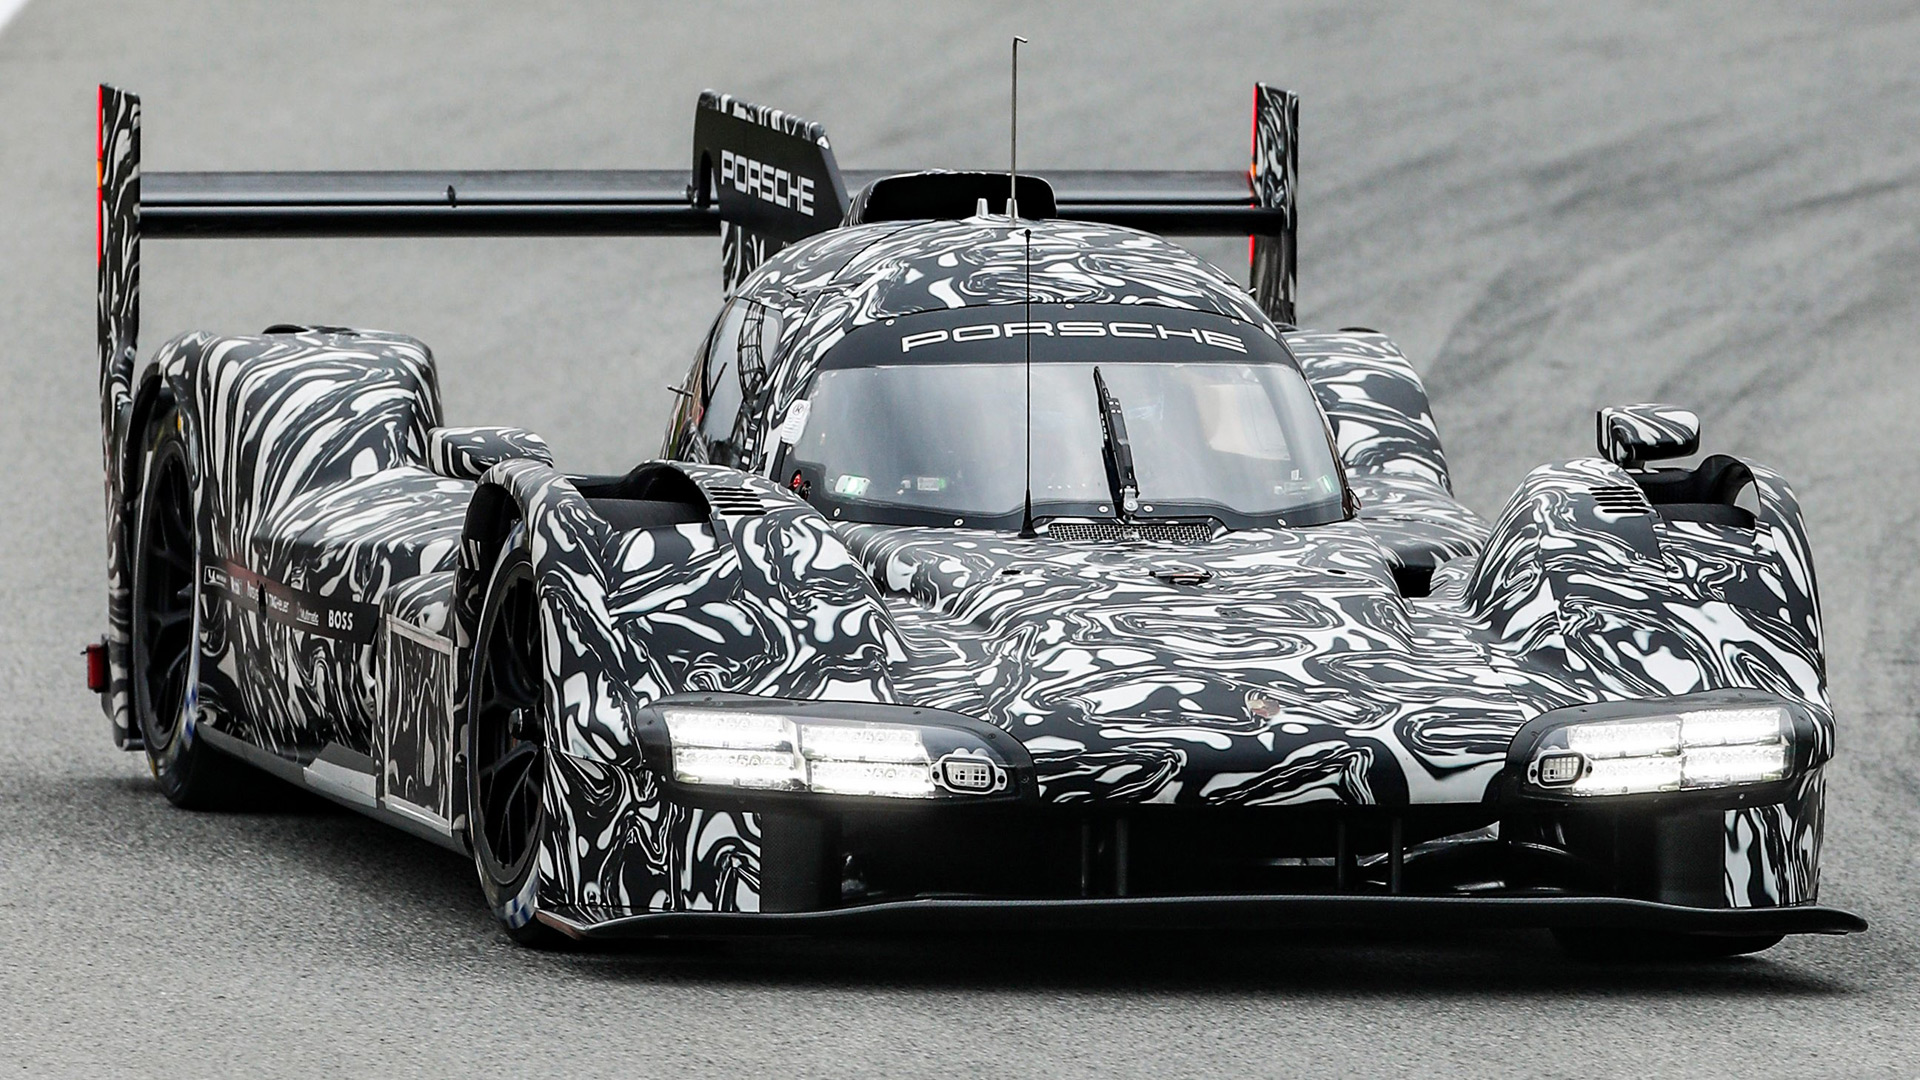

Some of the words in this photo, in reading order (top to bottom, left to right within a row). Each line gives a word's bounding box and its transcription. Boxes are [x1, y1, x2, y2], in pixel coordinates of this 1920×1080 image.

[721, 149, 815, 217] PORSCHE
[901, 320, 1248, 354] PORSCHE
[328, 608, 354, 631] BOSS
